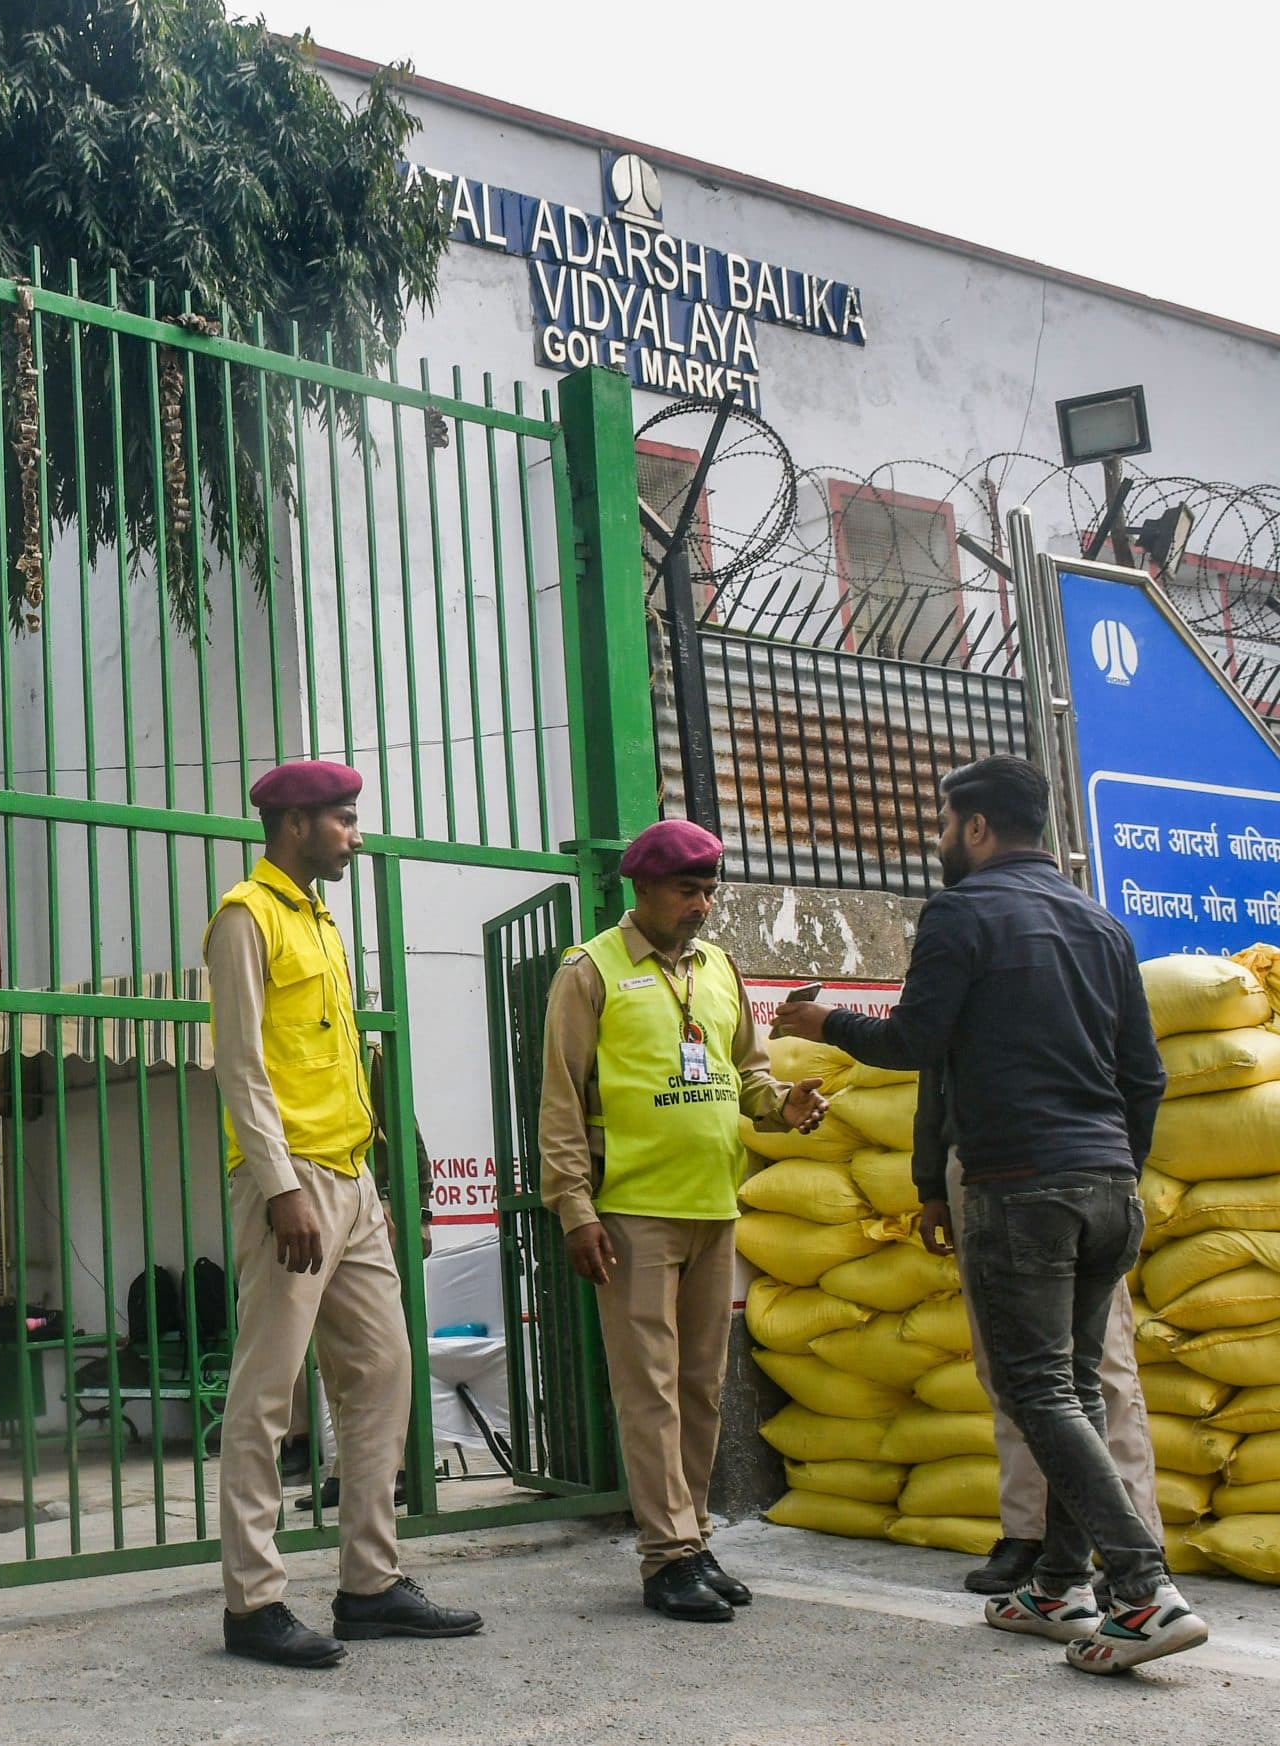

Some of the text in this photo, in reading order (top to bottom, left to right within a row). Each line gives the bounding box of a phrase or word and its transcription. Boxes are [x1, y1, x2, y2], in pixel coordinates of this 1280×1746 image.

[530, 198, 707, 300] ADARSH
[728, 253, 867, 341] BALIKA
[536, 260, 759, 370] VIDYALAYA
[639, 346, 759, 410] MARKET
[1114, 823, 1280, 862] अटल आदर्श बालिक
[1121, 879, 1198, 923] विद्यालय,
[1201, 885, 1237, 923] गोल
[752, 1001, 774, 1025] RSH
[654, 1093, 679, 1107] NEW
[683, 1091, 713, 1103] DELHI
[433, 1158, 478, 1178] KING
[429, 1185, 461, 1206] OR
